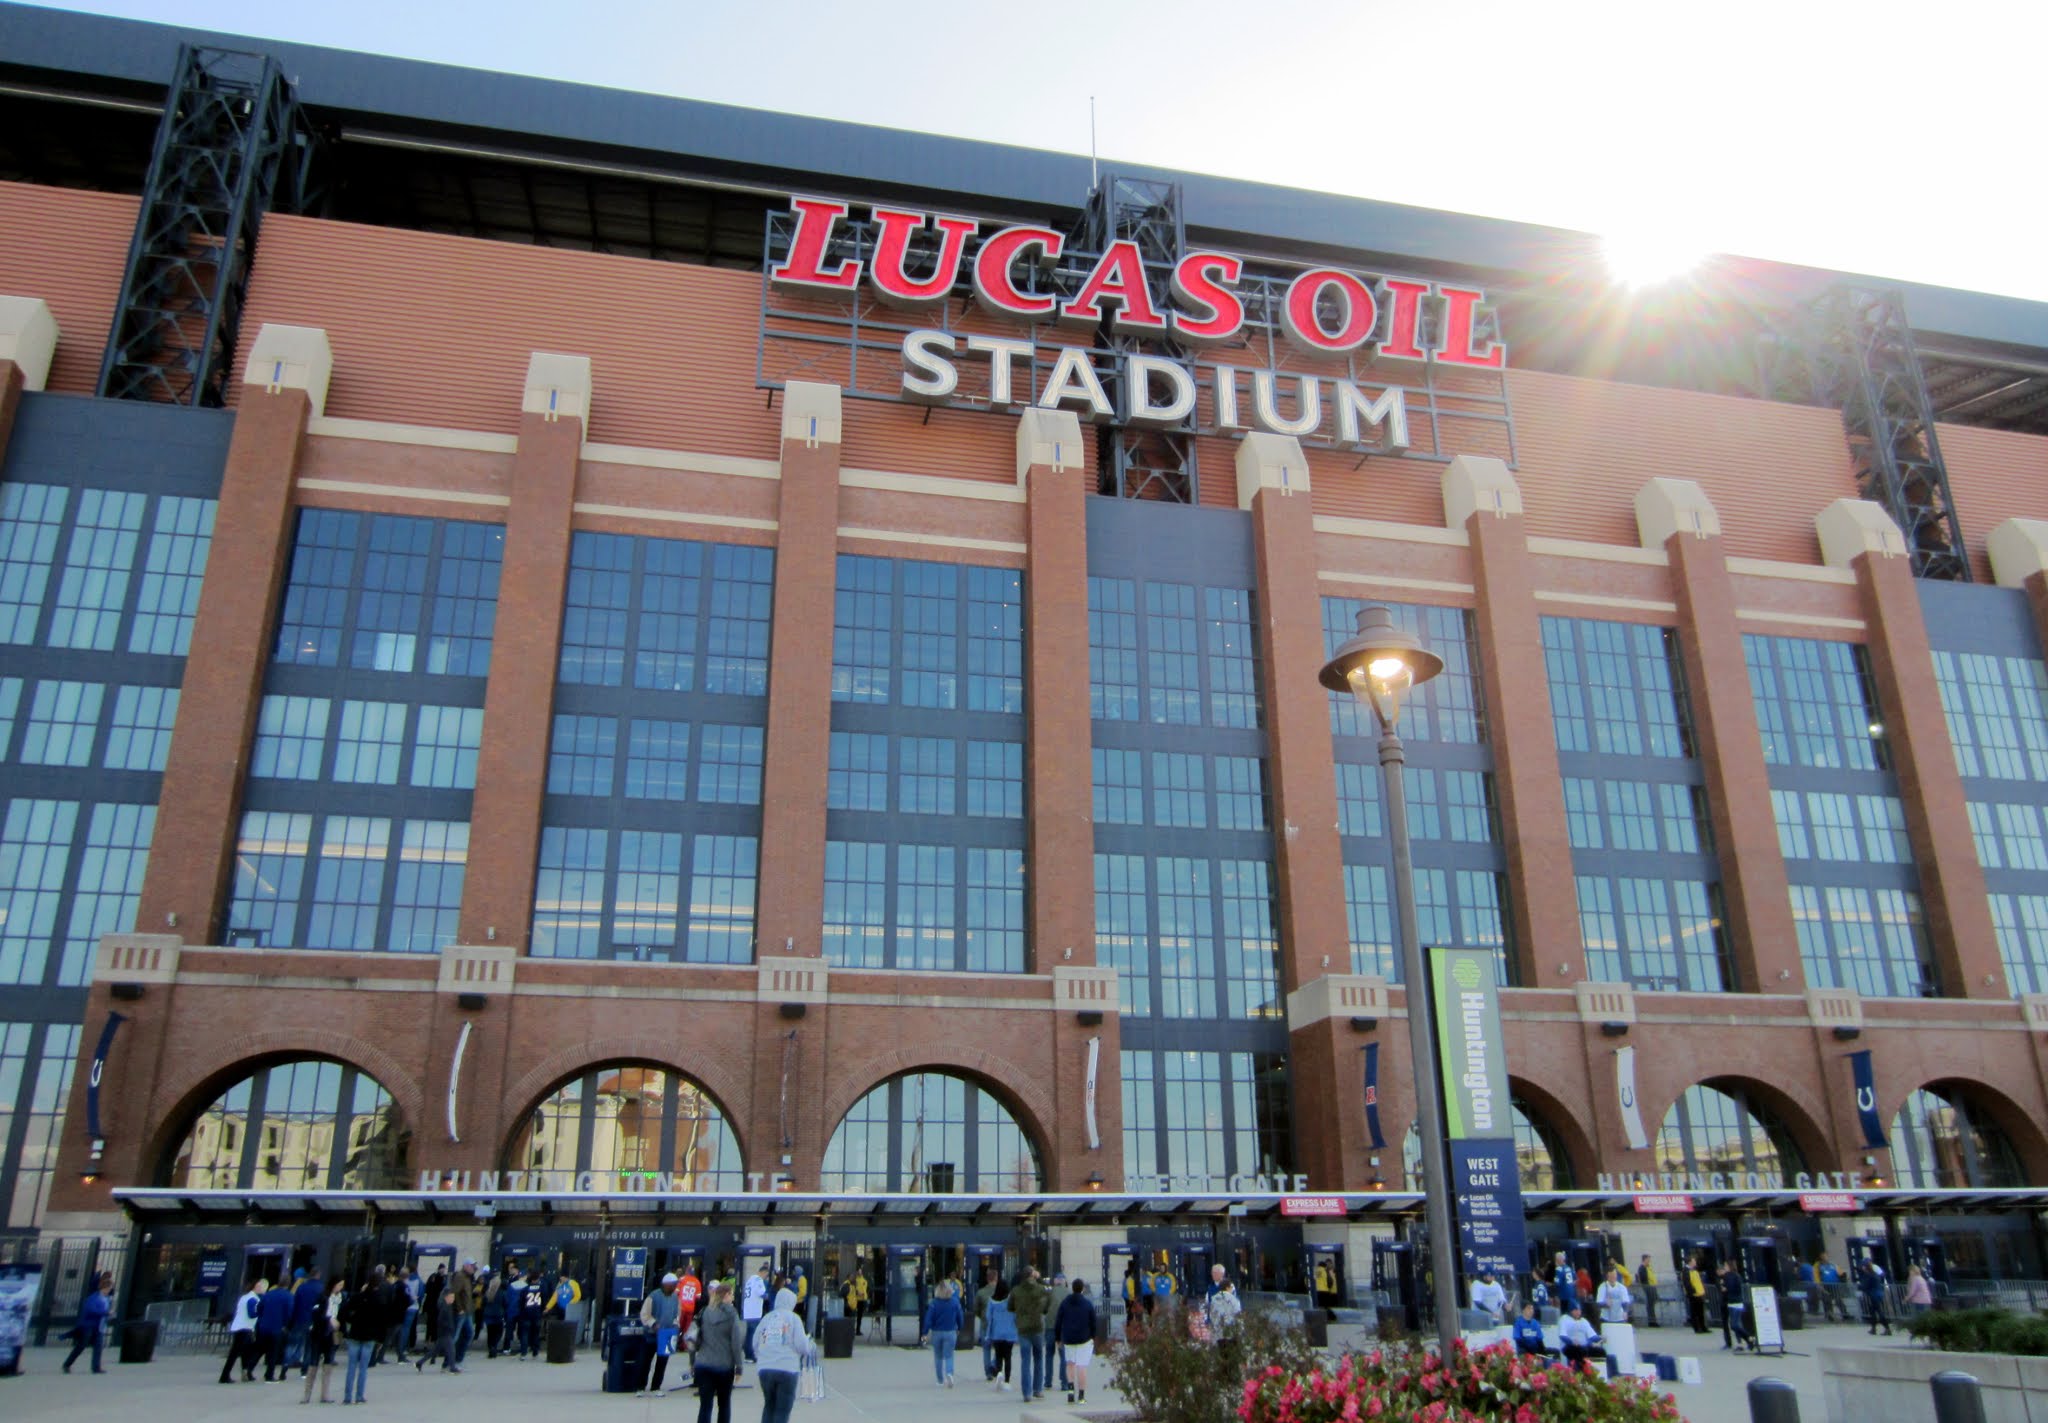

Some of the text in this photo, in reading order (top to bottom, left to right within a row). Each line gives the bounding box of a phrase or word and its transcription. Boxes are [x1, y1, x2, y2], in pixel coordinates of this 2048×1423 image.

[770, 196, 1506, 370] LUCAS OIL
[901, 329, 1410, 454] STADIUM
[1461, 992, 1492, 1129] Huntington
[1467, 1158, 1498, 1171] WEST
[695, 1172, 787, 1192] GTE
[1229, 1174, 1309, 1193] GATE
[1469, 1174, 1500, 1186] GATE
[1597, 1171, 1862, 1191] HUNTINGTON GATE
[1286, 1198, 1339, 1208] EXPRESS LANE
[1667, 1196, 1686, 1205] LANE
[1111, 1215, 1119, 1226] 6
[574, 1231, 665, 1240] HUNTNGTON GATE
[1179, 1231, 1200, 1239] WEST
[526, 1291, 542, 1306] 24
[682, 1285, 696, 1301] 58
